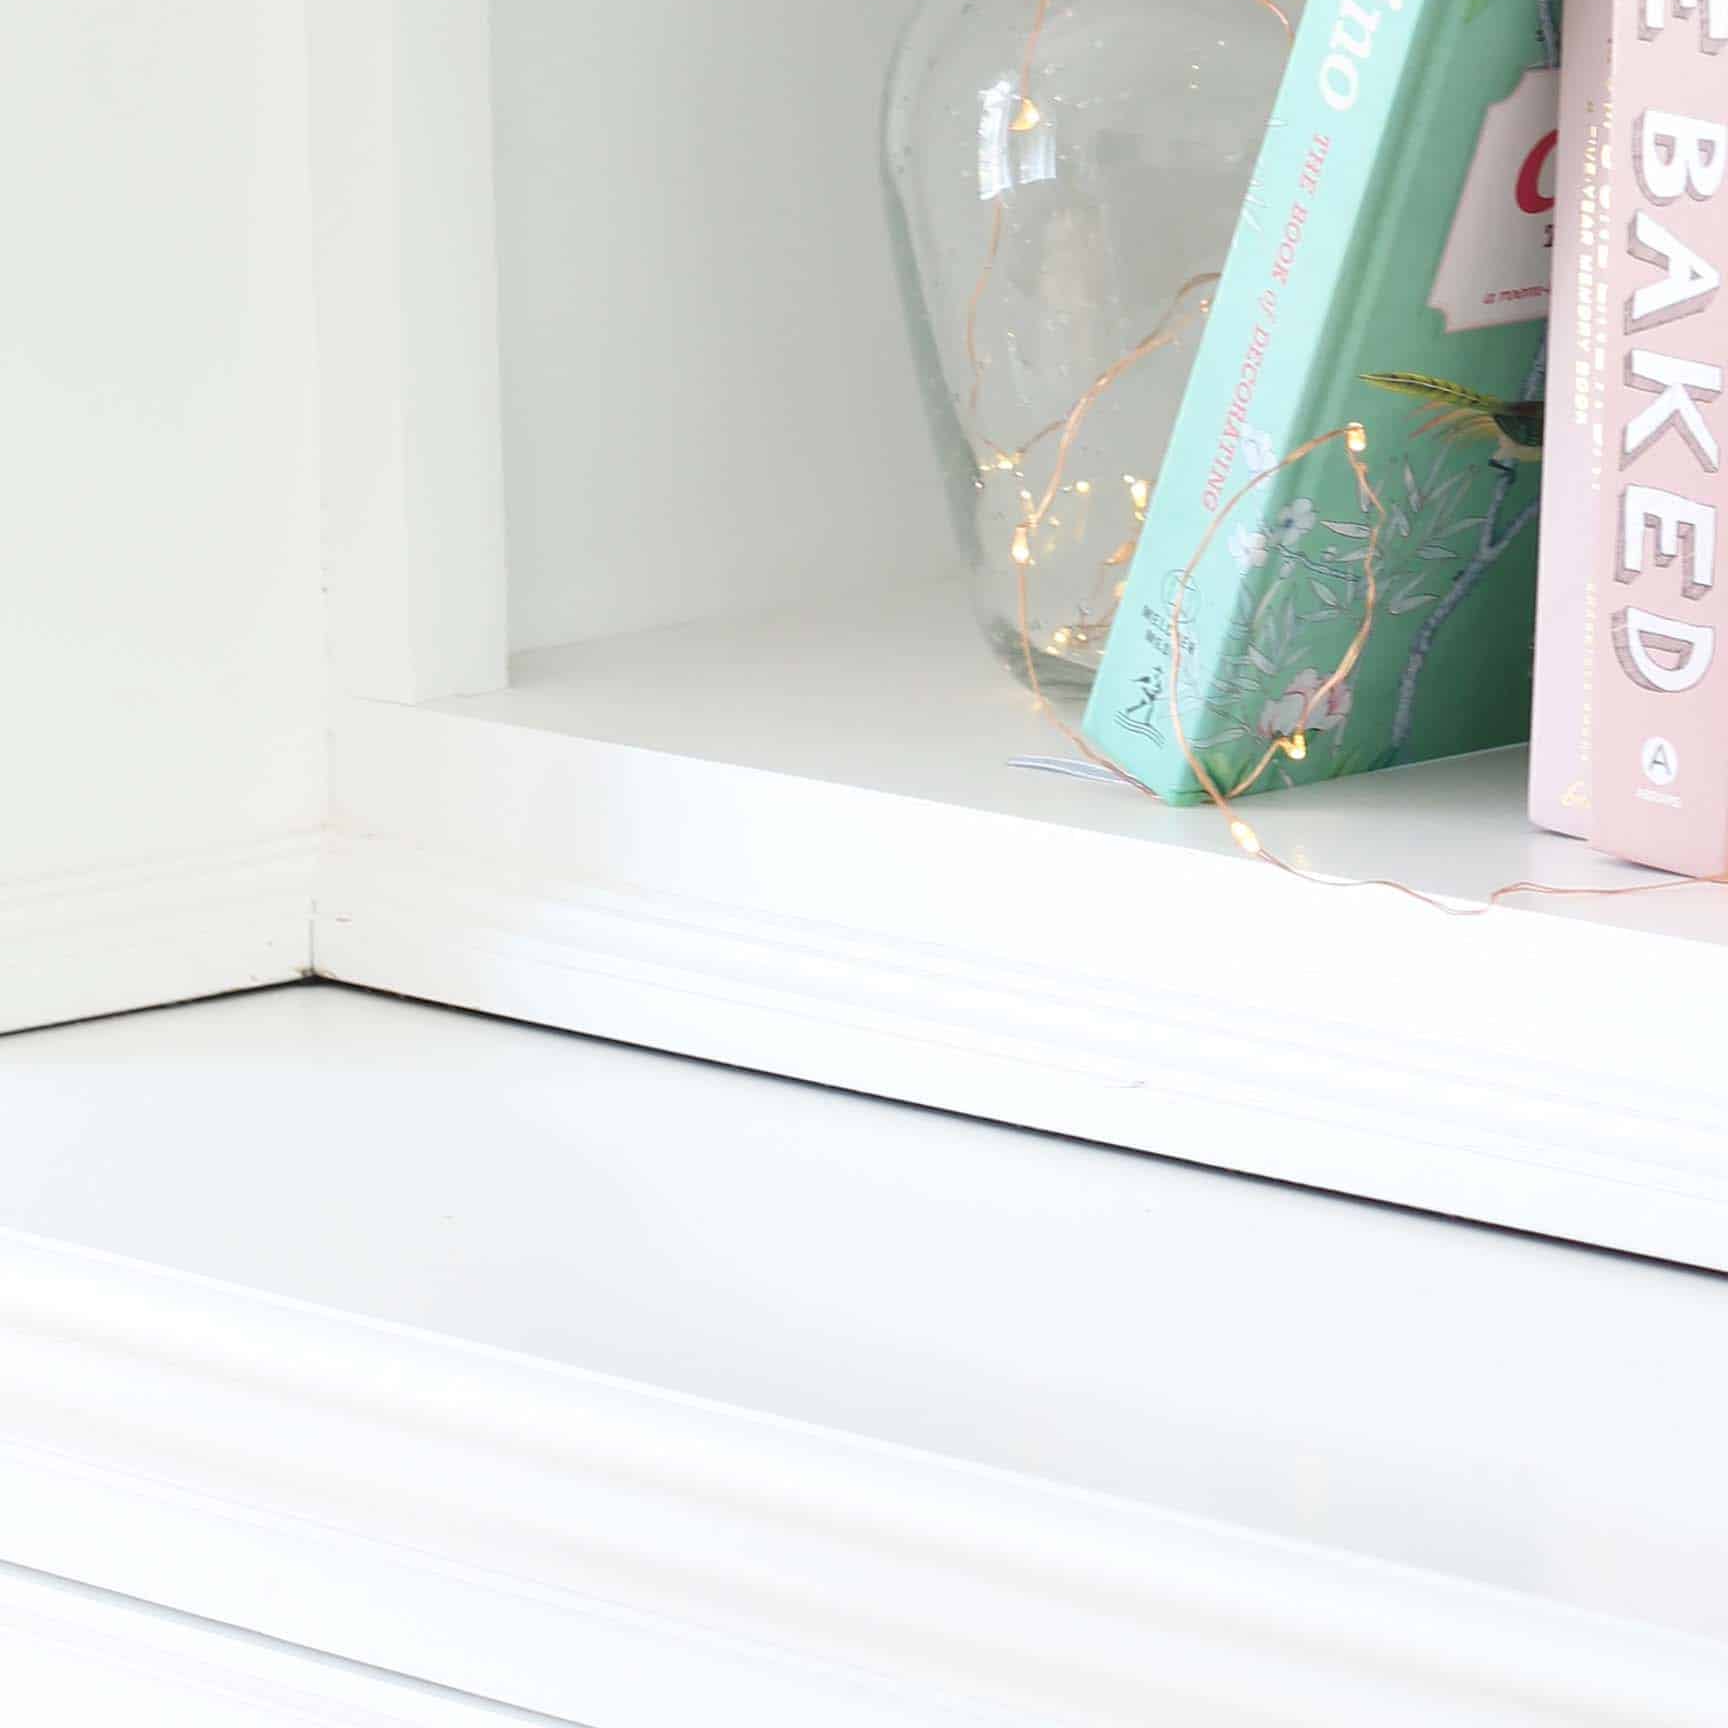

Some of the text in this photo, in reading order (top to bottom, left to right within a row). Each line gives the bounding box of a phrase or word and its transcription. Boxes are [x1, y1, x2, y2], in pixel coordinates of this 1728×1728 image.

[1202, 133, 1331, 513] THE BOOK DECORATING
[1616, 109, 1728, 692] BAKED
